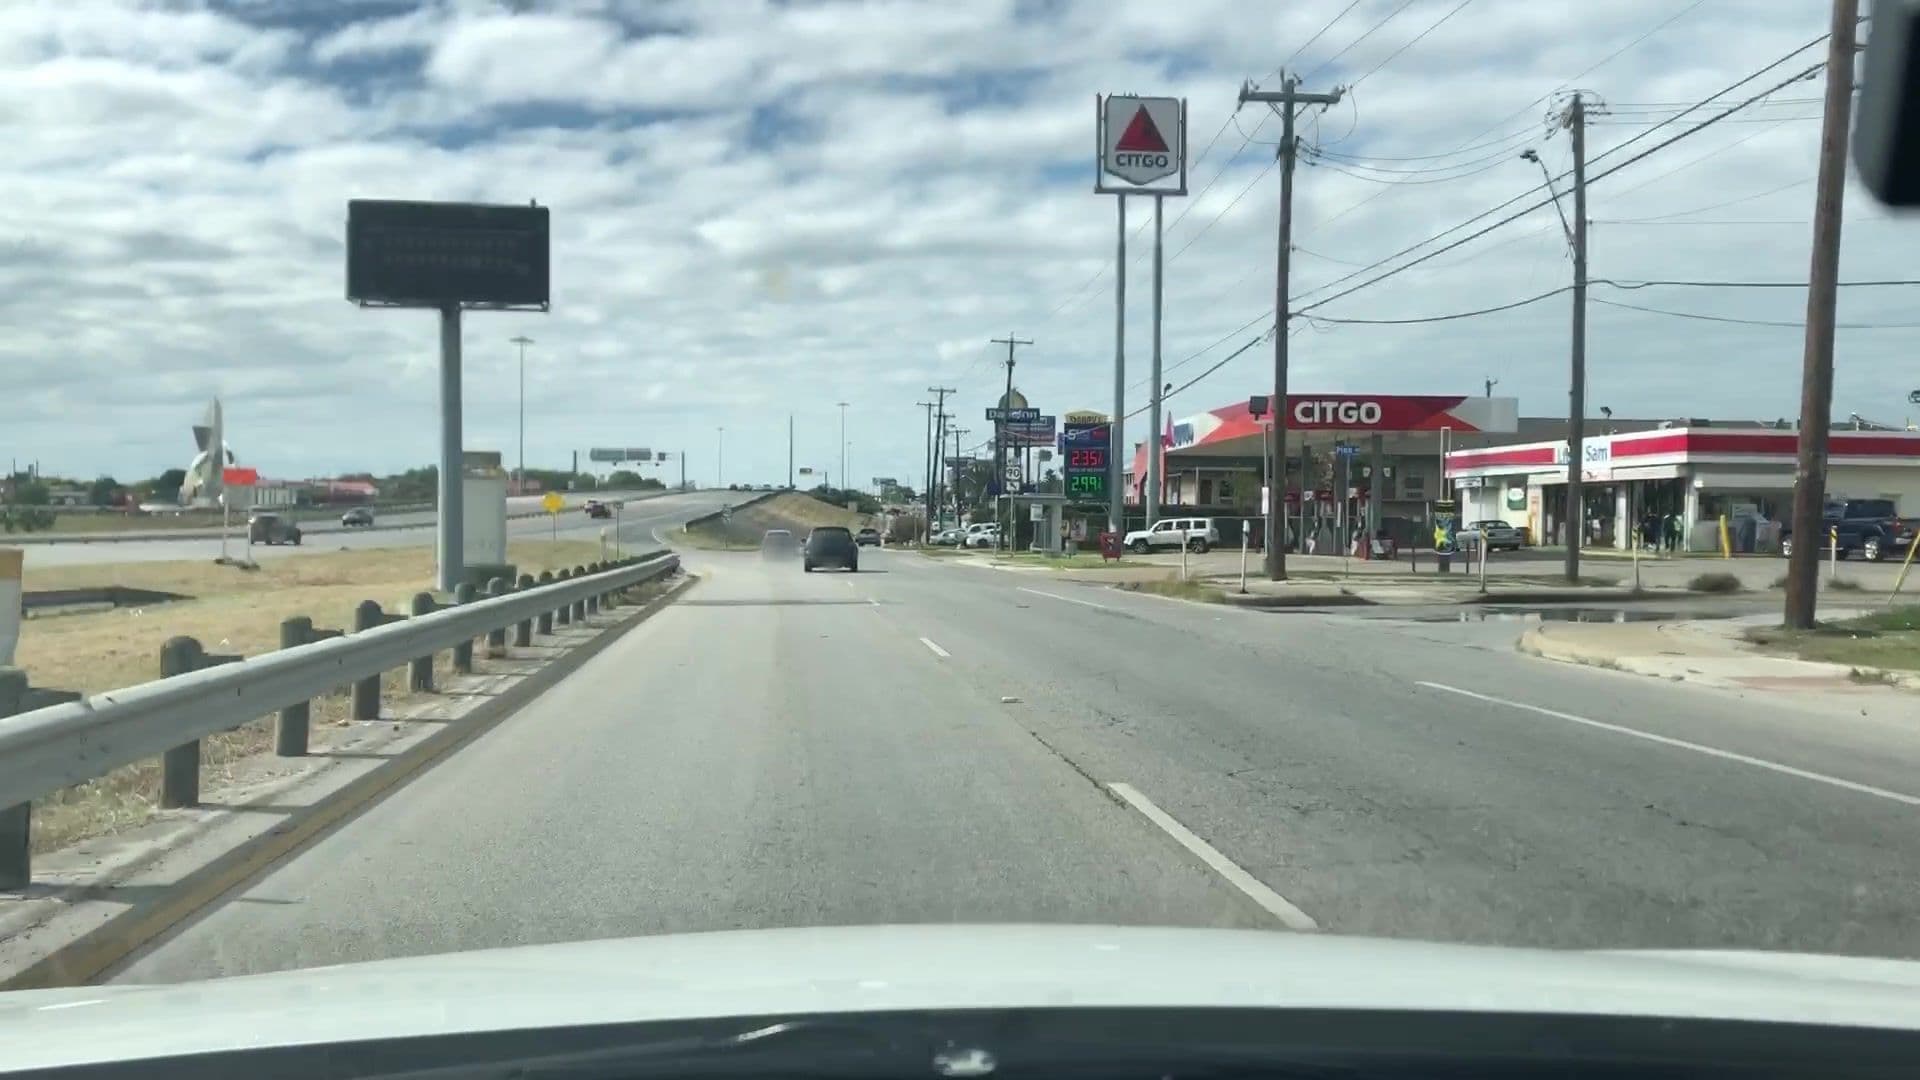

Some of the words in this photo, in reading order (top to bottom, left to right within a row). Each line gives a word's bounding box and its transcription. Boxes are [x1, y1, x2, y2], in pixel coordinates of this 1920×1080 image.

[1115, 153, 1169, 168] CITGO
[1294, 400, 1382, 424] CITGO
[1585, 445, 1609, 462] Sam
[1007, 468, 1020, 479] 90
